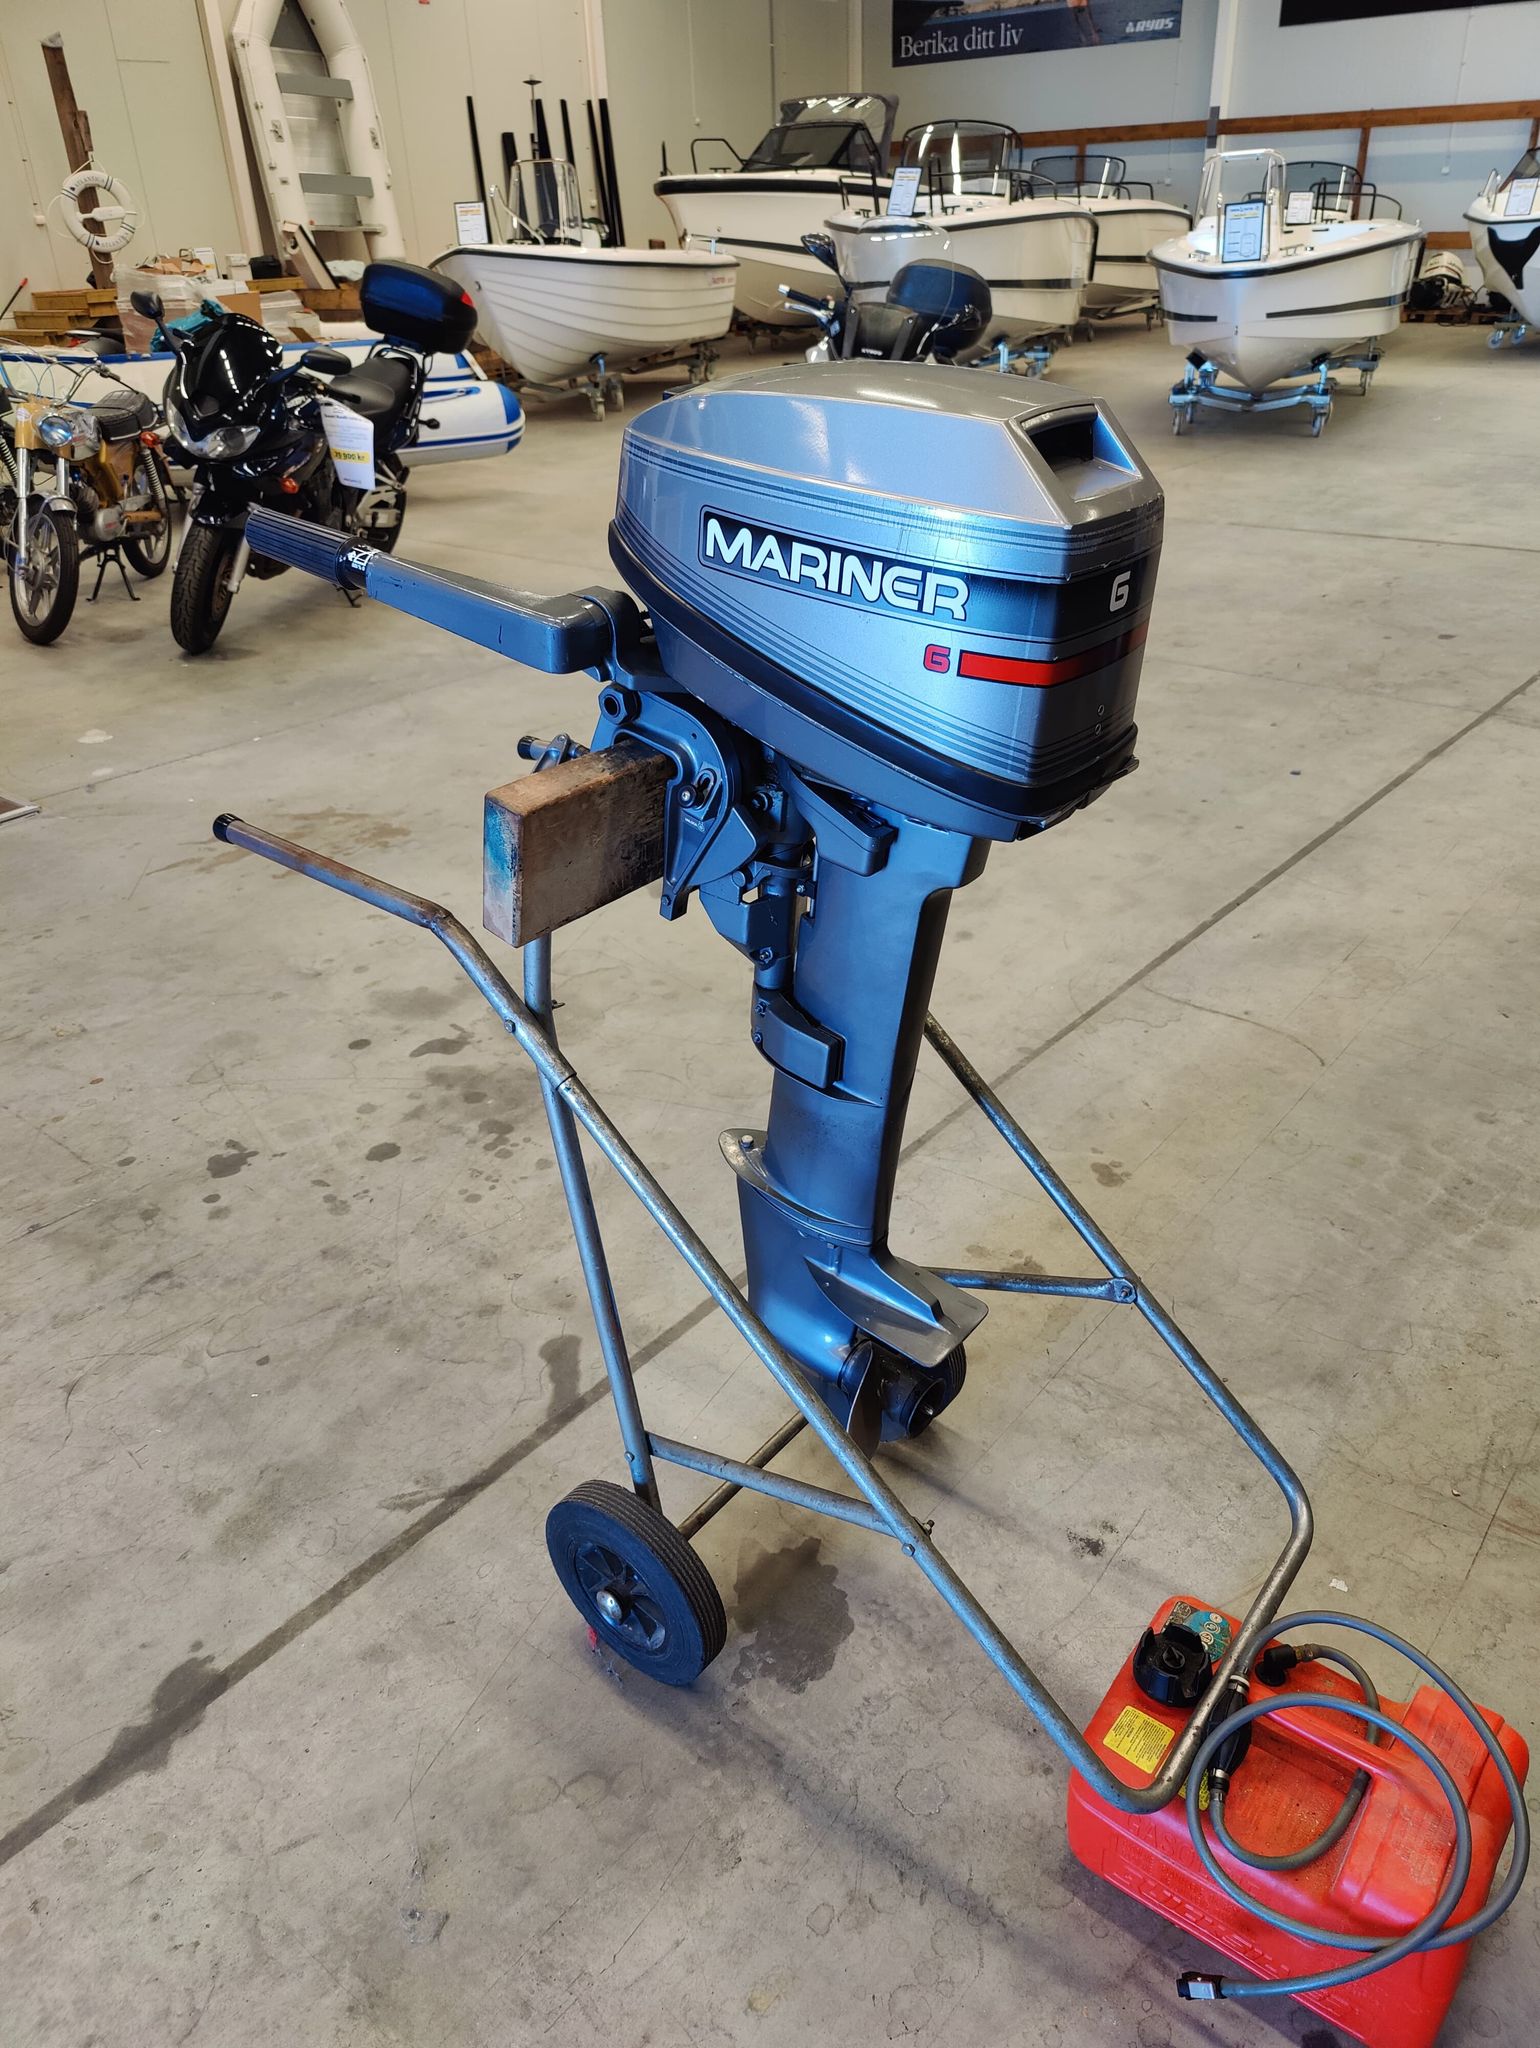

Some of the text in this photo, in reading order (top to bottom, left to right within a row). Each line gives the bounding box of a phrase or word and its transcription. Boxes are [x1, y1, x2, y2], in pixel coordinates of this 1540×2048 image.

[900, 22, 1024, 58] Berika ditt liv
[705, 518, 969, 621] MARINER
